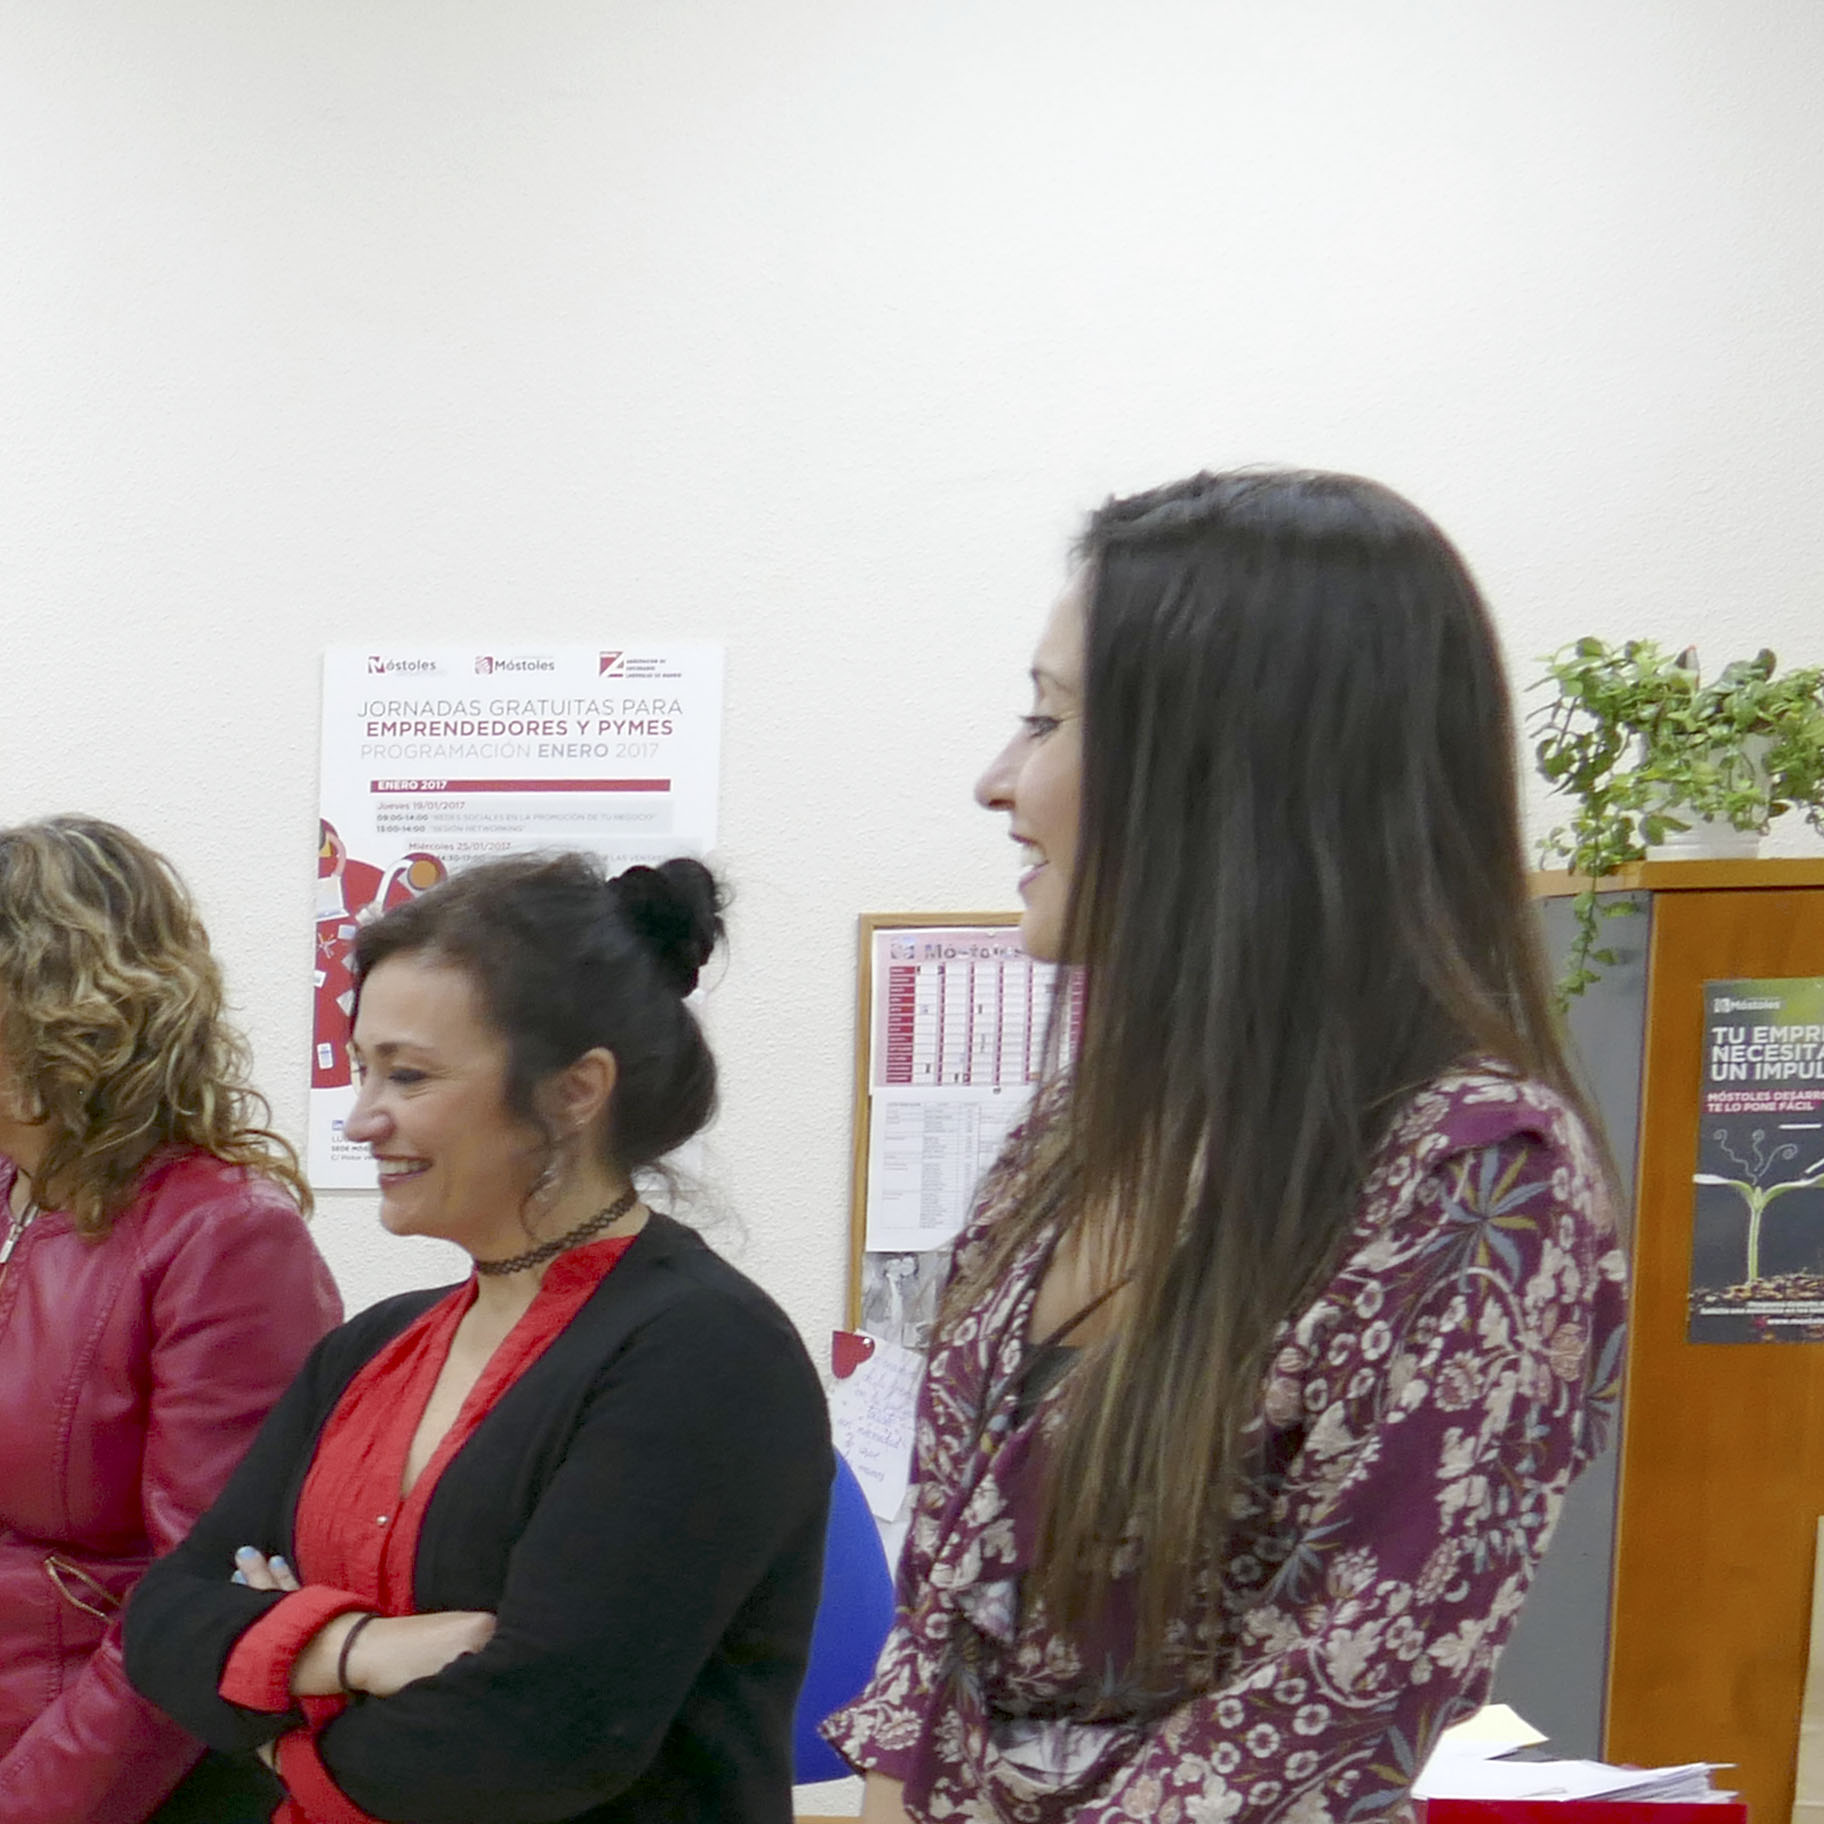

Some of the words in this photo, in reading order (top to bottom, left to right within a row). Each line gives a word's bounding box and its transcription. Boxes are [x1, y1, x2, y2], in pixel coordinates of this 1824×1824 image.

[494, 658, 555, 672] Móstoles
[357, 700, 482, 718] JORNADAS
[489, 698, 615, 716] GRATUITAS
[622, 698, 684, 716] PARA
[366, 720, 568, 737] EMPRENDEDORES
[575, 720, 591, 736] Y
[598, 719, 673, 735] PYMES
[360, 739, 530, 760] PROGRAMACIÓN
[537, 743, 609, 758] ENERO
[615, 743, 660, 758] 2017
[377, 780, 418, 791] ENERO
[420, 780, 448, 790] 2017
[377, 802, 410, 811] Jueves
[412, 801, 465, 811] 19/01/2017
[1712, 1026, 1745, 1044] TU
[1753, 1025, 1824, 1043] EMPR
[1712, 1062, 1746, 1081] UN
[1707, 1091, 1771, 1102] MÓSTOLES
[1708, 1102, 1723, 1112] TE
[1725, 1102, 1741, 1112] LO
[1743, 1101, 1777, 1112] PONE
[1779, 1100, 1815, 1111] FÁCIL
